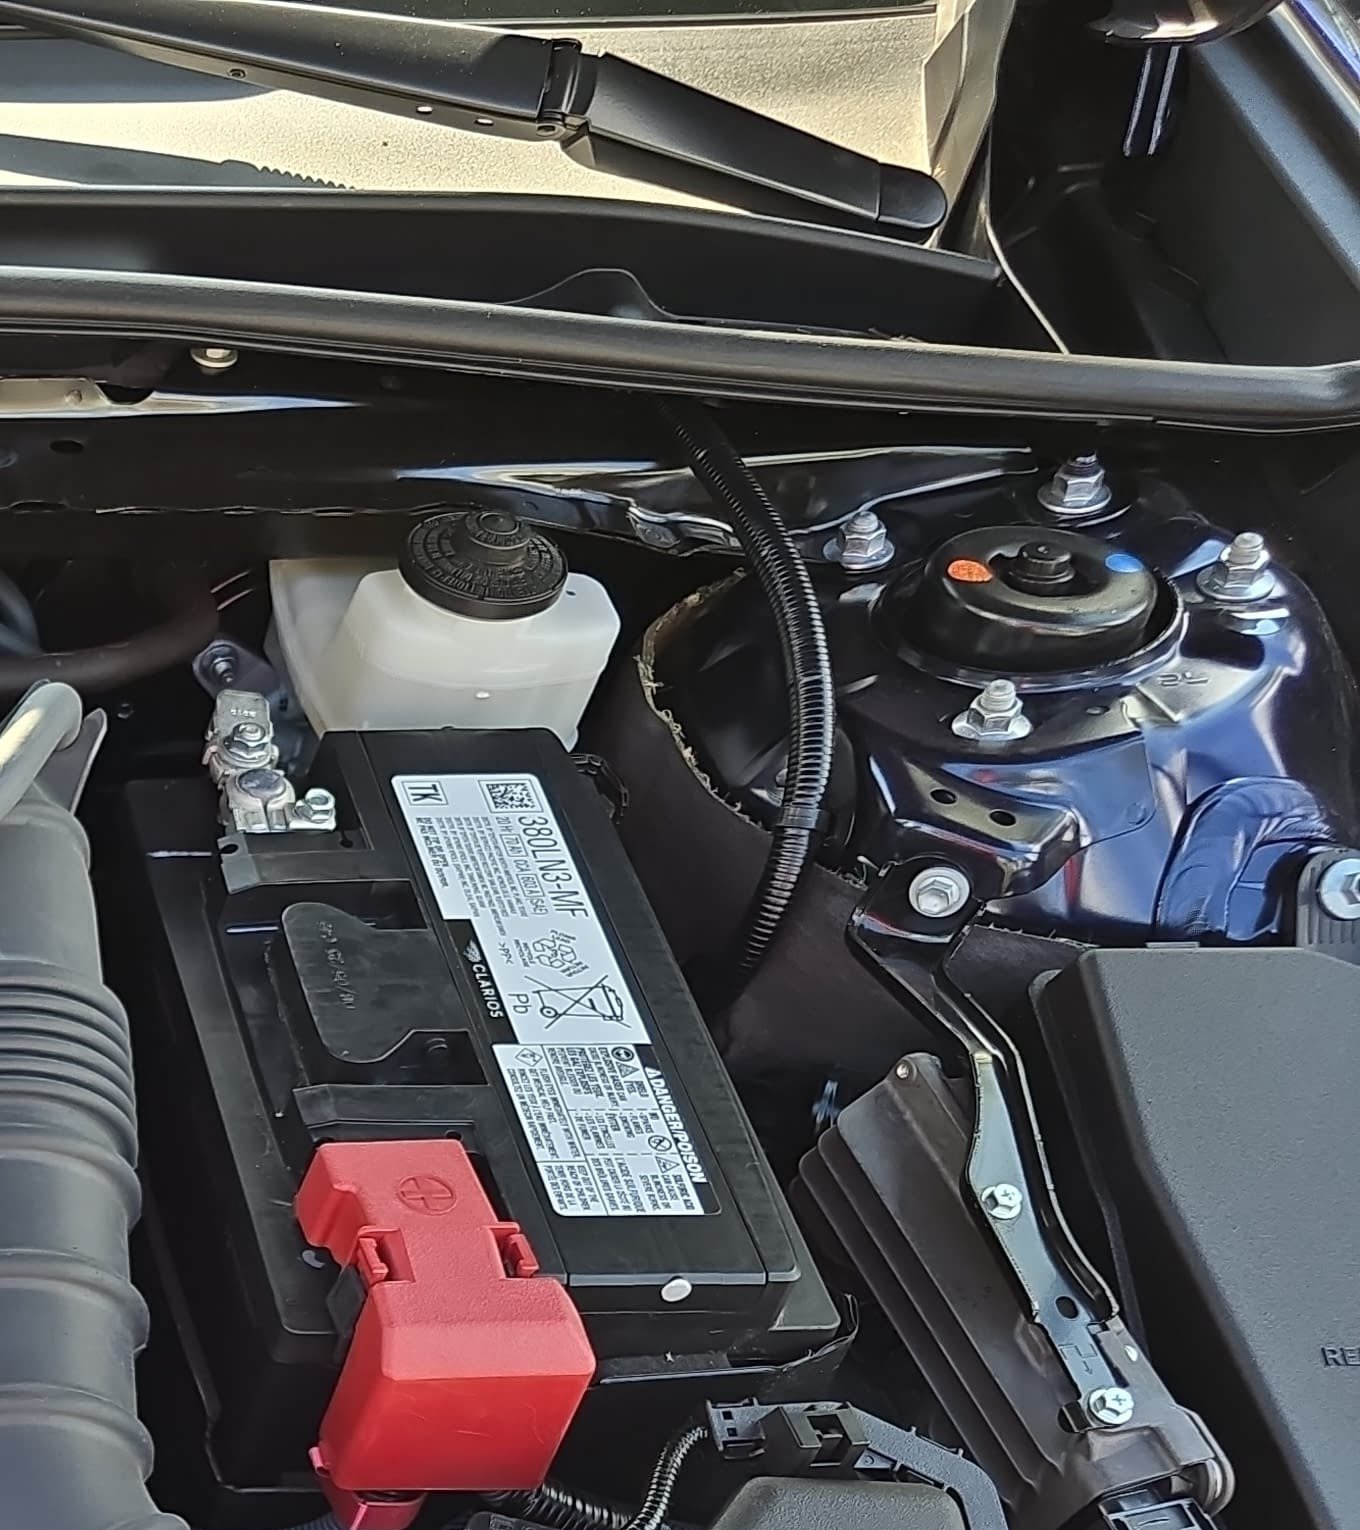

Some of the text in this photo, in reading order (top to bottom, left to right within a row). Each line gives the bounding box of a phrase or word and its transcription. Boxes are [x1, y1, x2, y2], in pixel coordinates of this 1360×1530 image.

[403, 783, 443, 802] TK
[512, 859, 531, 872] CCA
[514, 815, 589, 917] 380LN3-MF
[471, 961, 504, 1019] CLARIOS
[506, 993, 536, 1014] Pb
[649, 1078, 707, 1182] DANGER/POISON
[1320, 1346, 1360, 1368] RE
